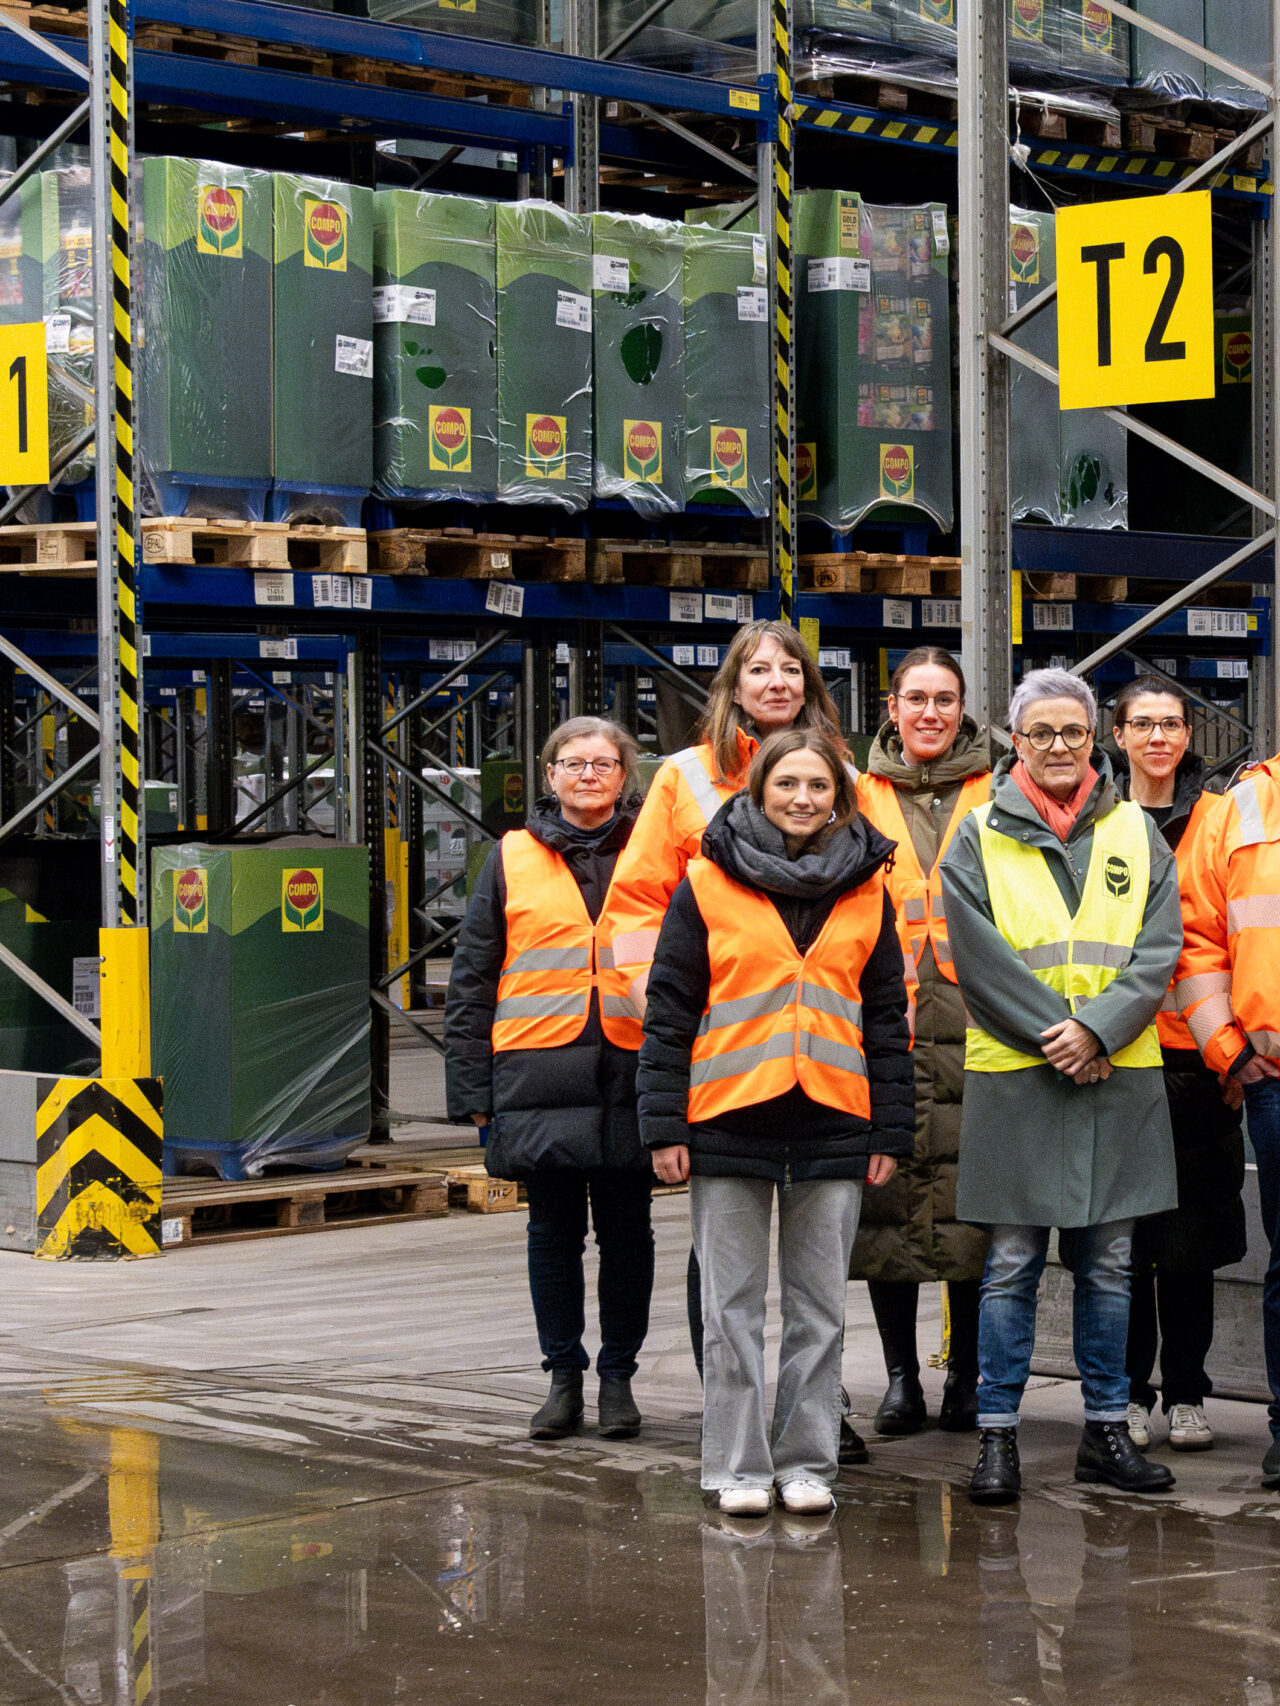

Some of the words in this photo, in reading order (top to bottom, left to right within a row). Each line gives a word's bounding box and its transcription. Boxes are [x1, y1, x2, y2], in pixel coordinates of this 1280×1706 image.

[311, 216, 341, 233] COMPO
[1081, 236, 1186, 367] T2
[436, 421, 465, 435] COMPO
[532, 430, 560, 443] COMPO
[629, 435, 657, 448] COMPO
[716, 440, 741, 454] COMPO
[885, 457, 909, 470] COMPO
[1106, 863, 1128, 876] COMPO
[178, 884, 203, 897] COMPO
[288, 883, 317, 896] COMPO
